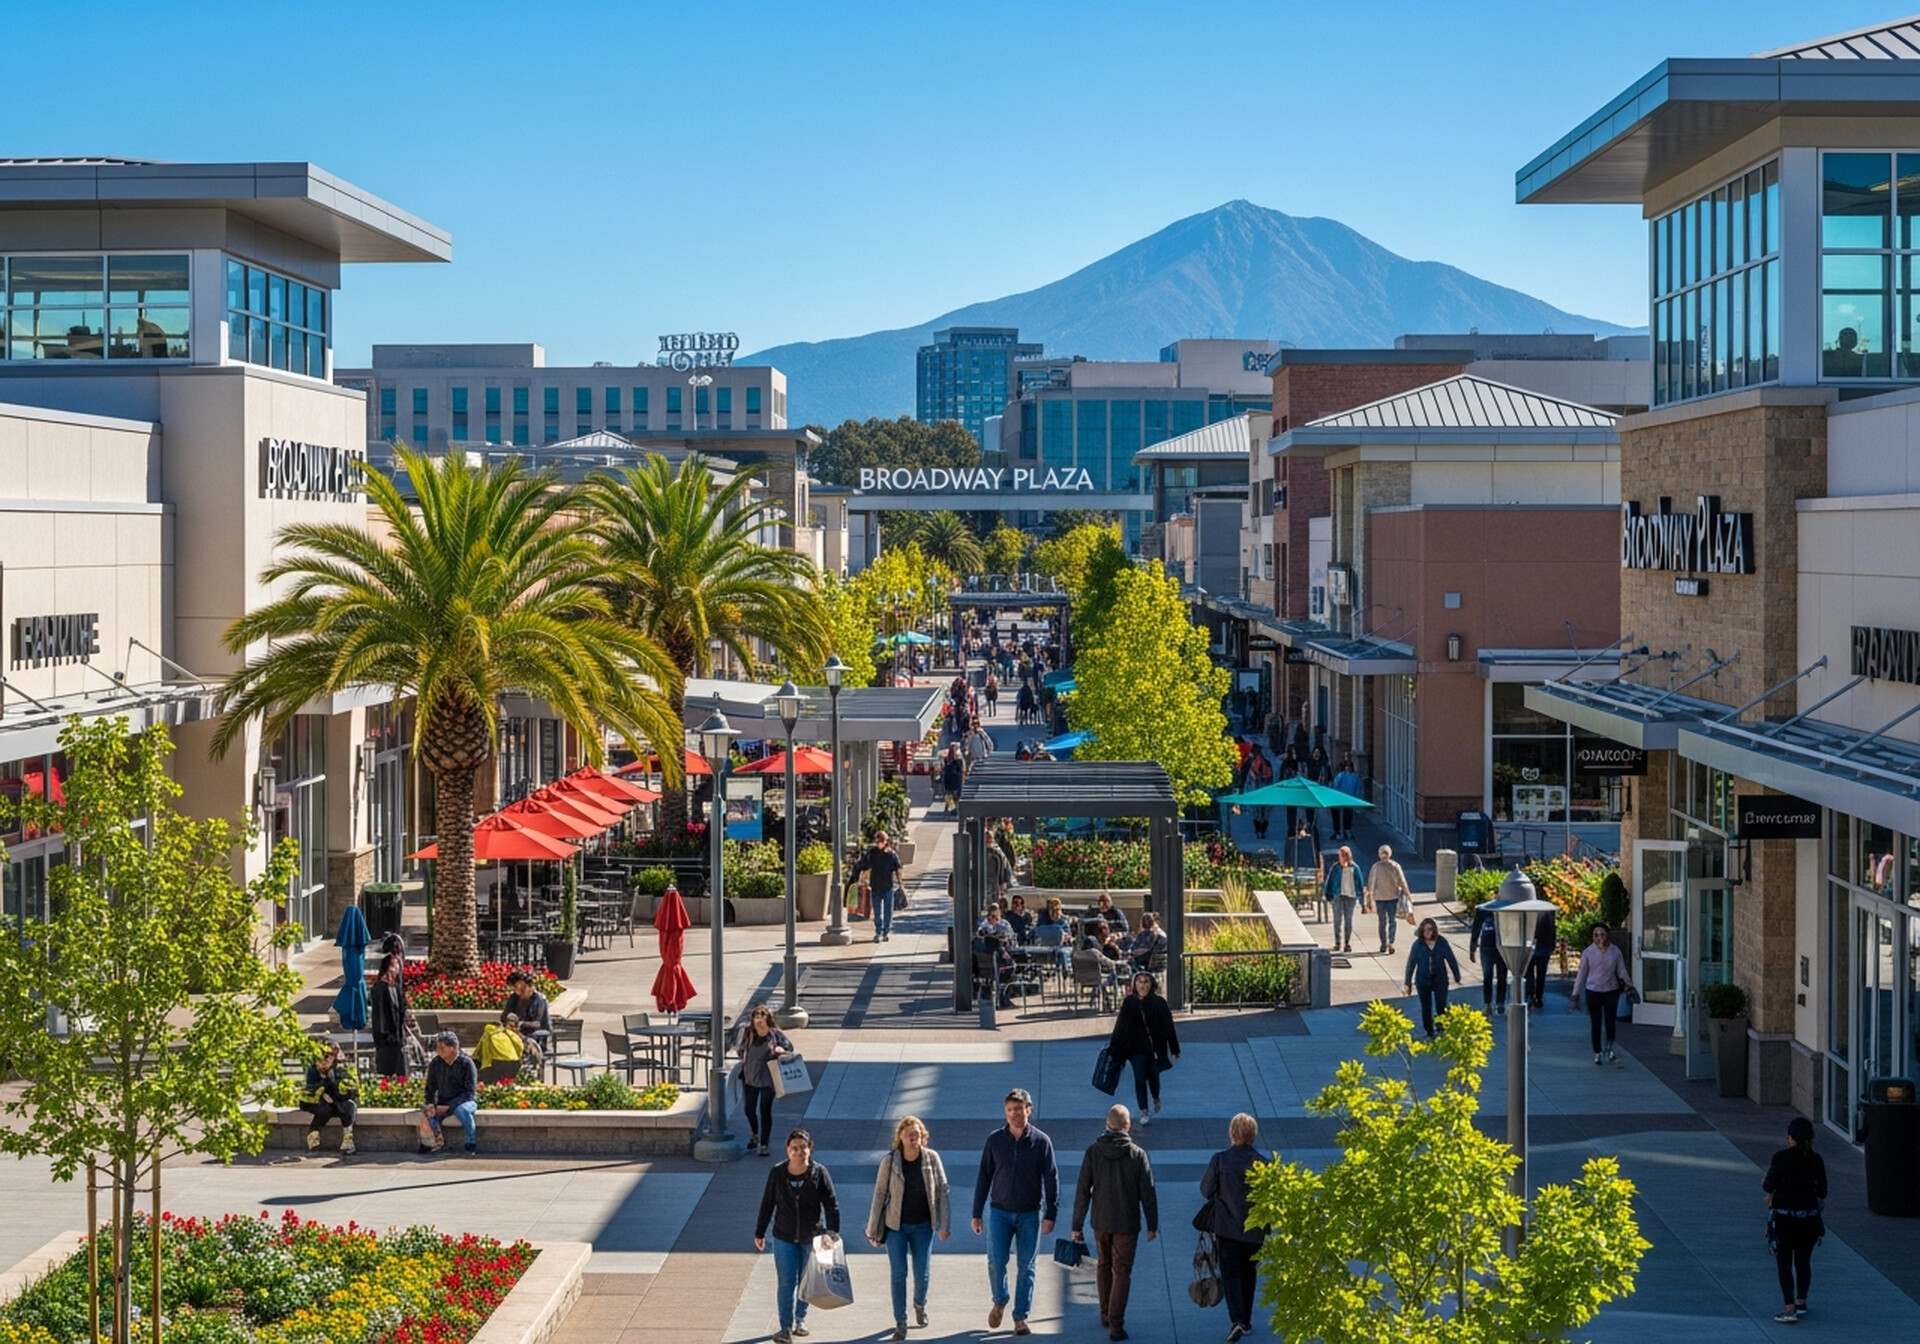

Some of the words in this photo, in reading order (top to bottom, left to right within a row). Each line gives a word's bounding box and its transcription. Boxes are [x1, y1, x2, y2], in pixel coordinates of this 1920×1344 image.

[860, 467, 1004, 490] BROADWAY
[1013, 467, 1094, 490] PLAZA
[1696, 495, 1745, 574] PLAZA
